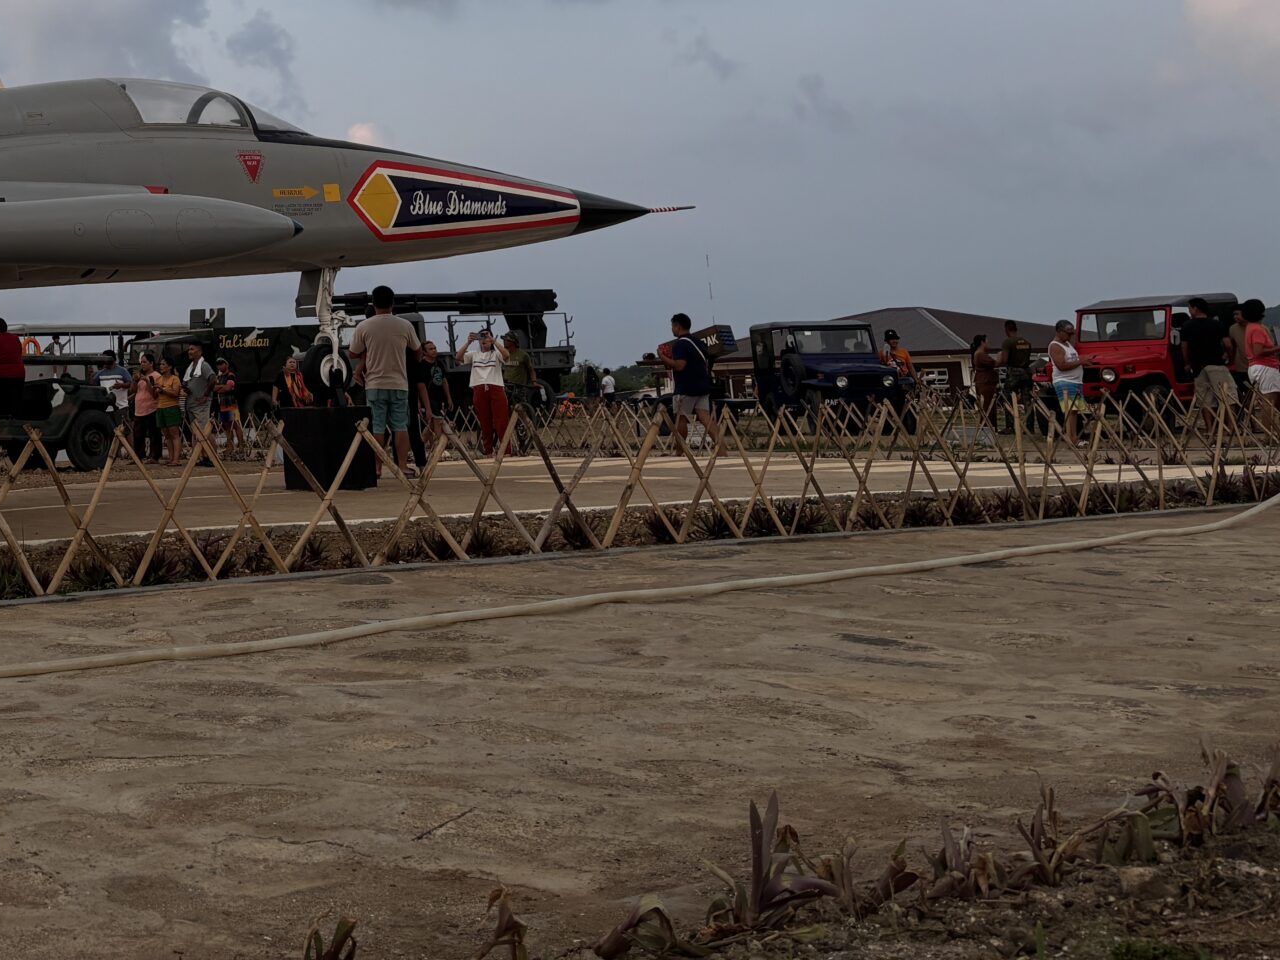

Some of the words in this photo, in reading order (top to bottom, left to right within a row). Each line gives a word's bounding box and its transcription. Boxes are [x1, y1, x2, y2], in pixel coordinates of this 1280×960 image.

[410, 189, 444, 215] Blue
[445, 190, 507, 215] Diamonds
[219, 334, 269, 349] Talisman
